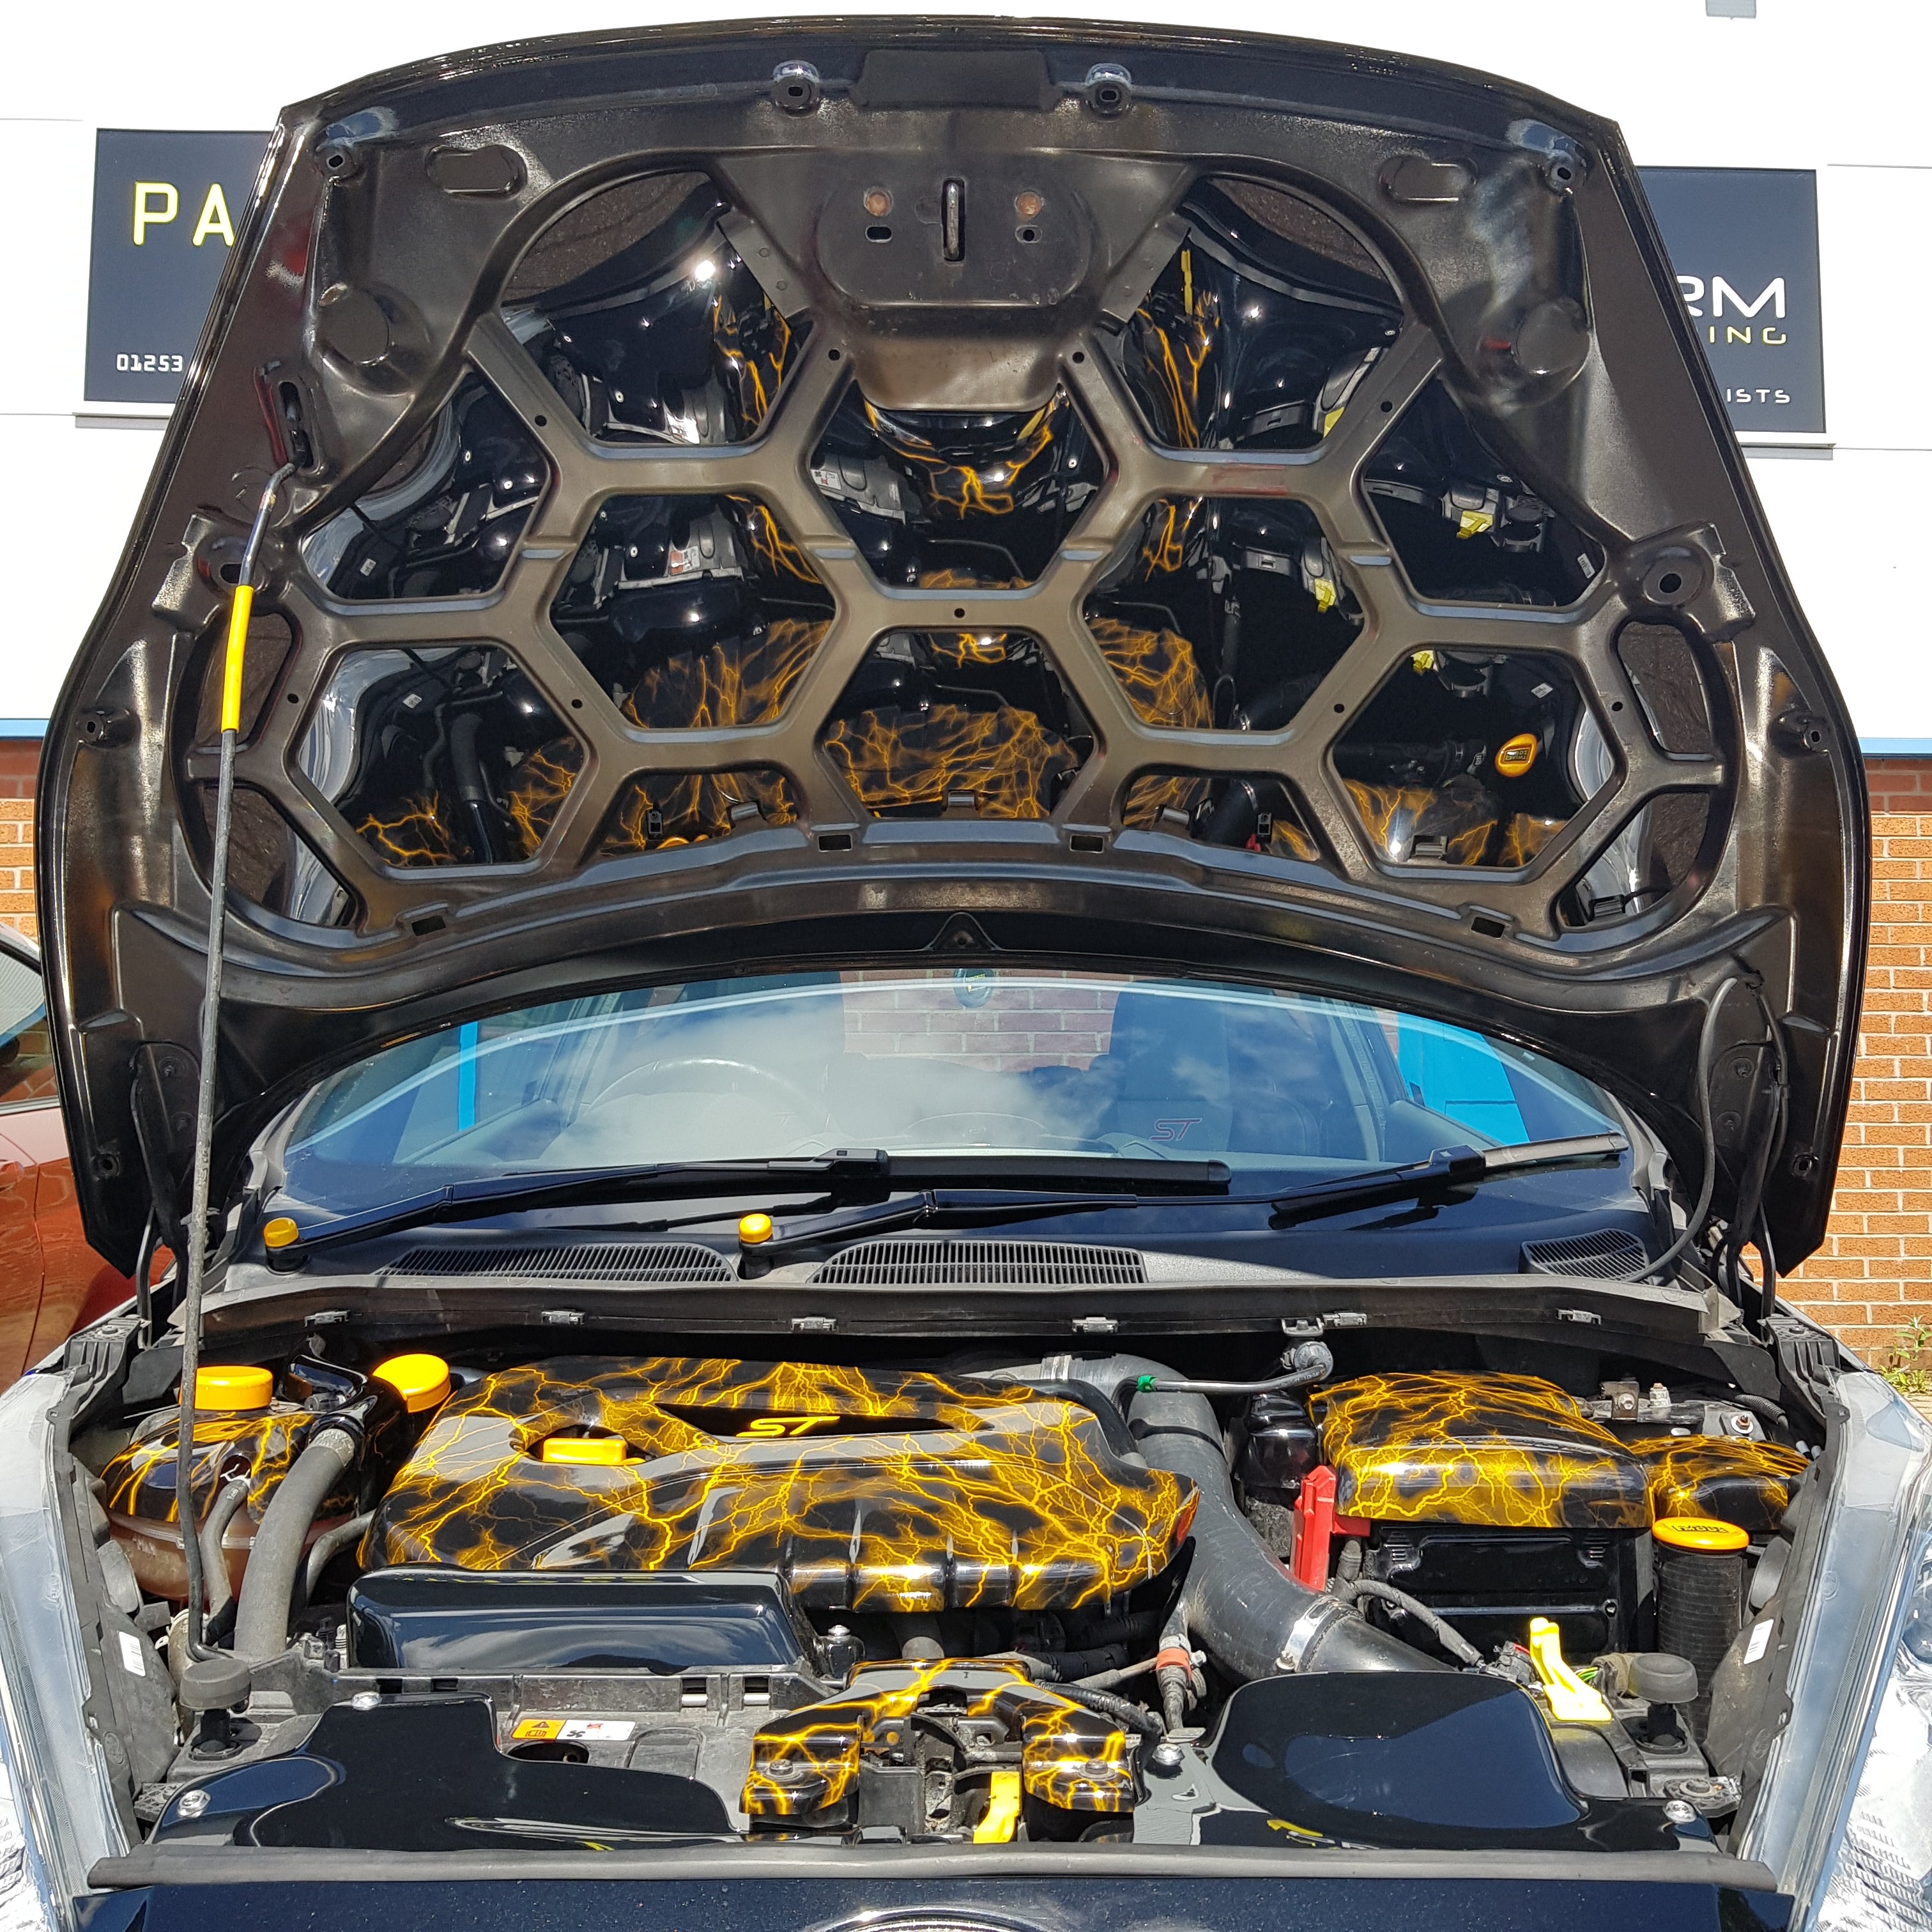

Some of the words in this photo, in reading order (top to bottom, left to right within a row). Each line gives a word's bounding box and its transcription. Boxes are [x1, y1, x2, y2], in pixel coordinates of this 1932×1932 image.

[1709, 326, 1786, 344] ING
[116, 353, 183, 372] 01253
[1726, 388, 1790, 403] ISTS
[1149, 1117, 1202, 1140] ST
[736, 1416, 840, 1437] ST
